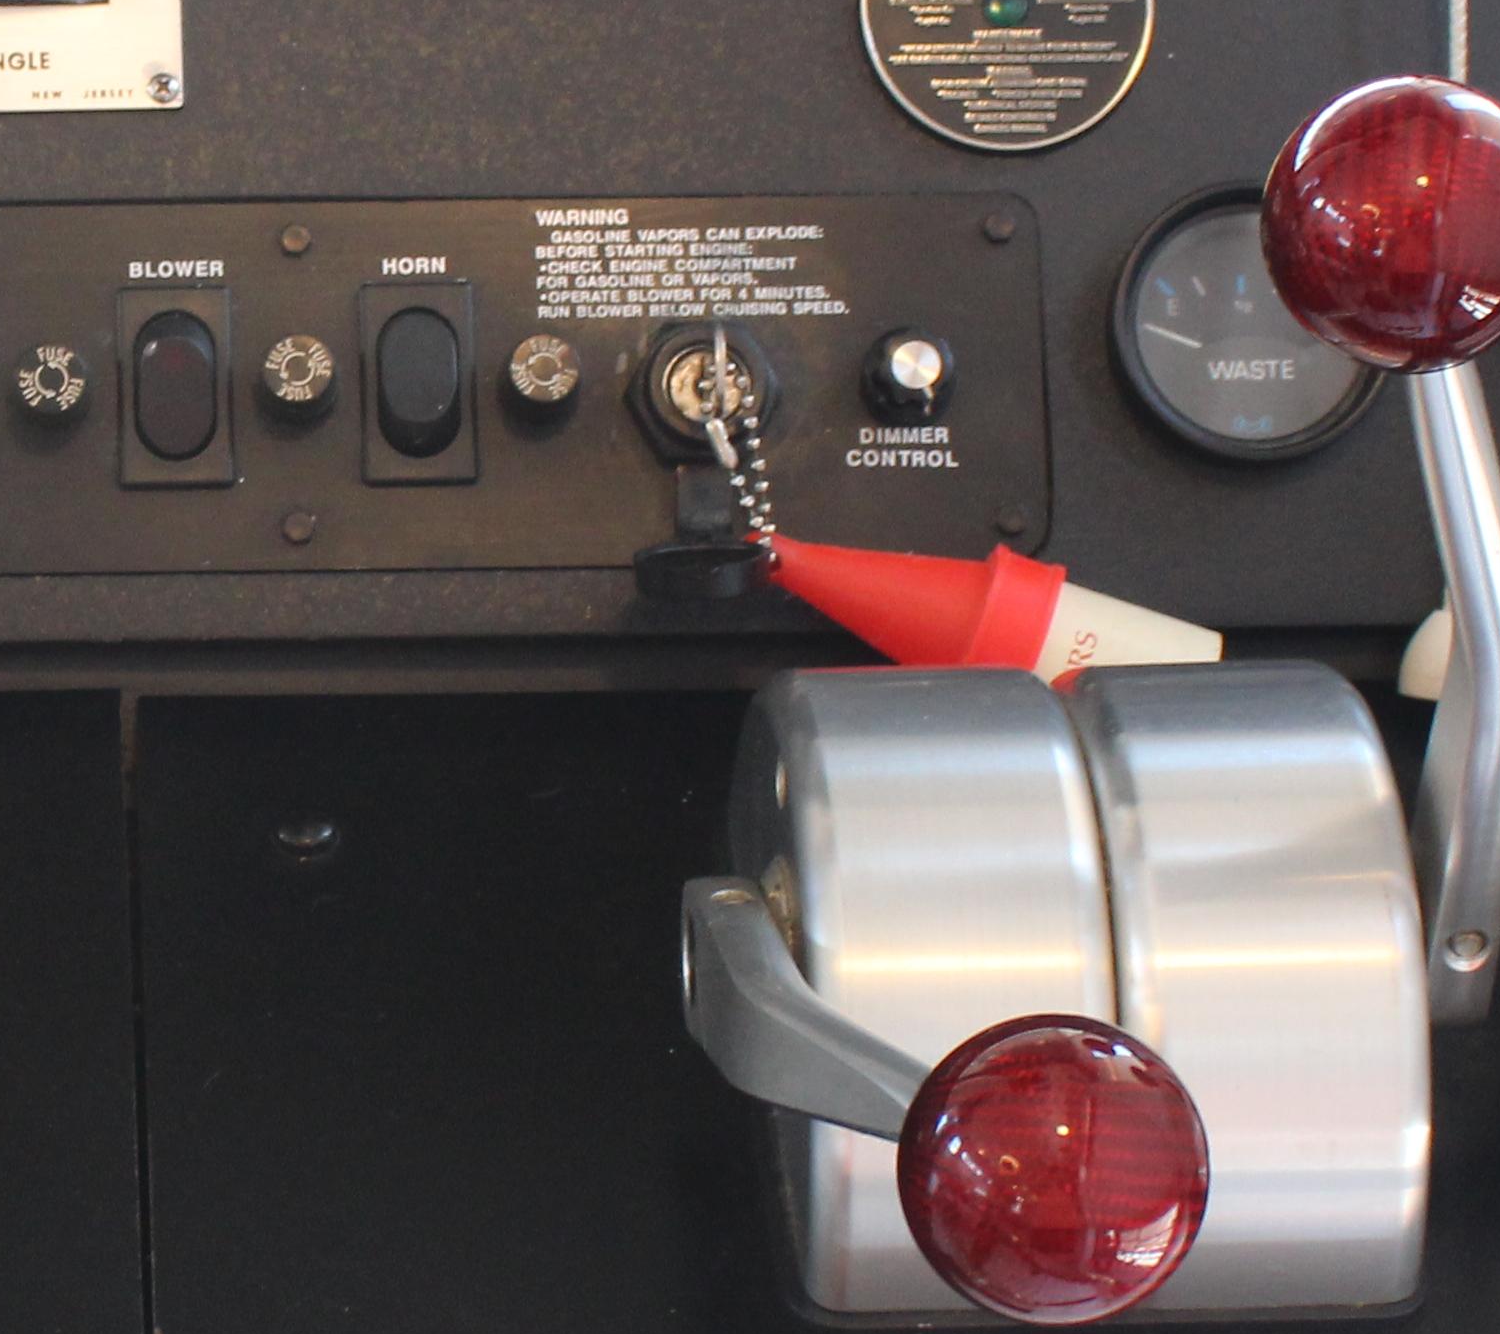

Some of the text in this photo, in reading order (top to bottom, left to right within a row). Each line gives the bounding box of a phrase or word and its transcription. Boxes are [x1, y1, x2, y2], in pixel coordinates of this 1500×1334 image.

[32, 89, 63, 100] NEW
[84, 87, 134, 99] JERSEY
[535, 209, 629, 226] WARNING
[551, 225, 824, 244] GASOLINE VAPORS CAN EXPLODE:
[535, 245, 598, 259] BEFORE
[605, 243, 684, 258] STARTING
[128, 260, 225, 279] BLOWER
[382, 257, 446, 275] HORN
[610, 259, 668, 273] ENGINE
[674, 257, 797, 272] COMPARTMENT
[536, 272, 758, 289] FOR GASOLINE OR VAPORS.
[627, 288, 695, 303] BLOWER
[700, 288, 732, 301] FOR
[738, 287, 748, 300] 4
[754, 286, 830, 300] MINUTES.
[537, 301, 850, 319] RUN BLOWER BELOW CRUISING SPEED.
[36, 346, 76, 367] FUSE
[1208, 359, 1296, 381] WASTE
[18, 369, 44, 407] FUSE
[859, 427, 949, 446] DIMMER
[846, 450, 959, 468] CONTROL
